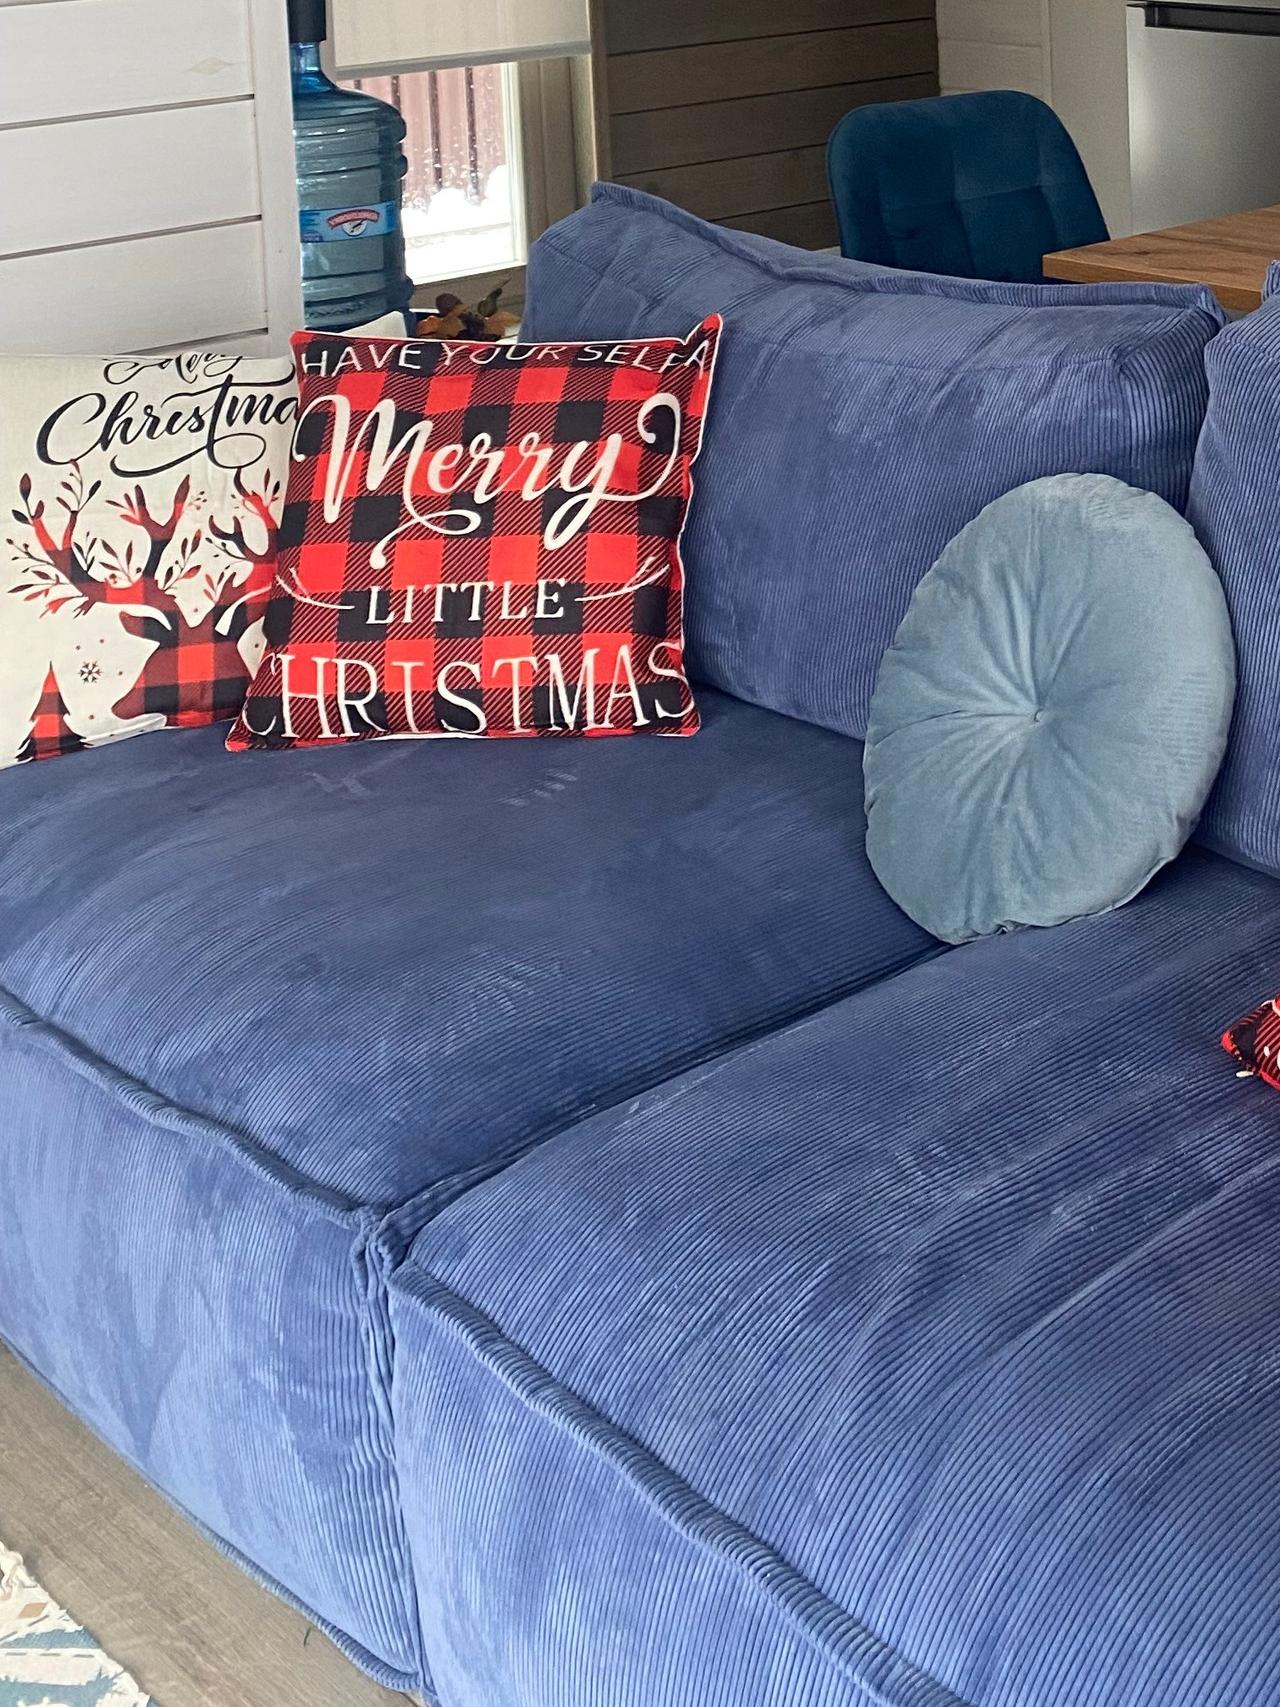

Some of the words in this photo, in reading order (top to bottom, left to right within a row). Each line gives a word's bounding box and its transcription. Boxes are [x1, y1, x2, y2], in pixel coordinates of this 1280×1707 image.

[301, 342, 422, 378] HAVE
[36, 364, 299, 477] Christma
[291, 391, 681, 570] Merry
[365, 577, 567, 625] LITTLE
